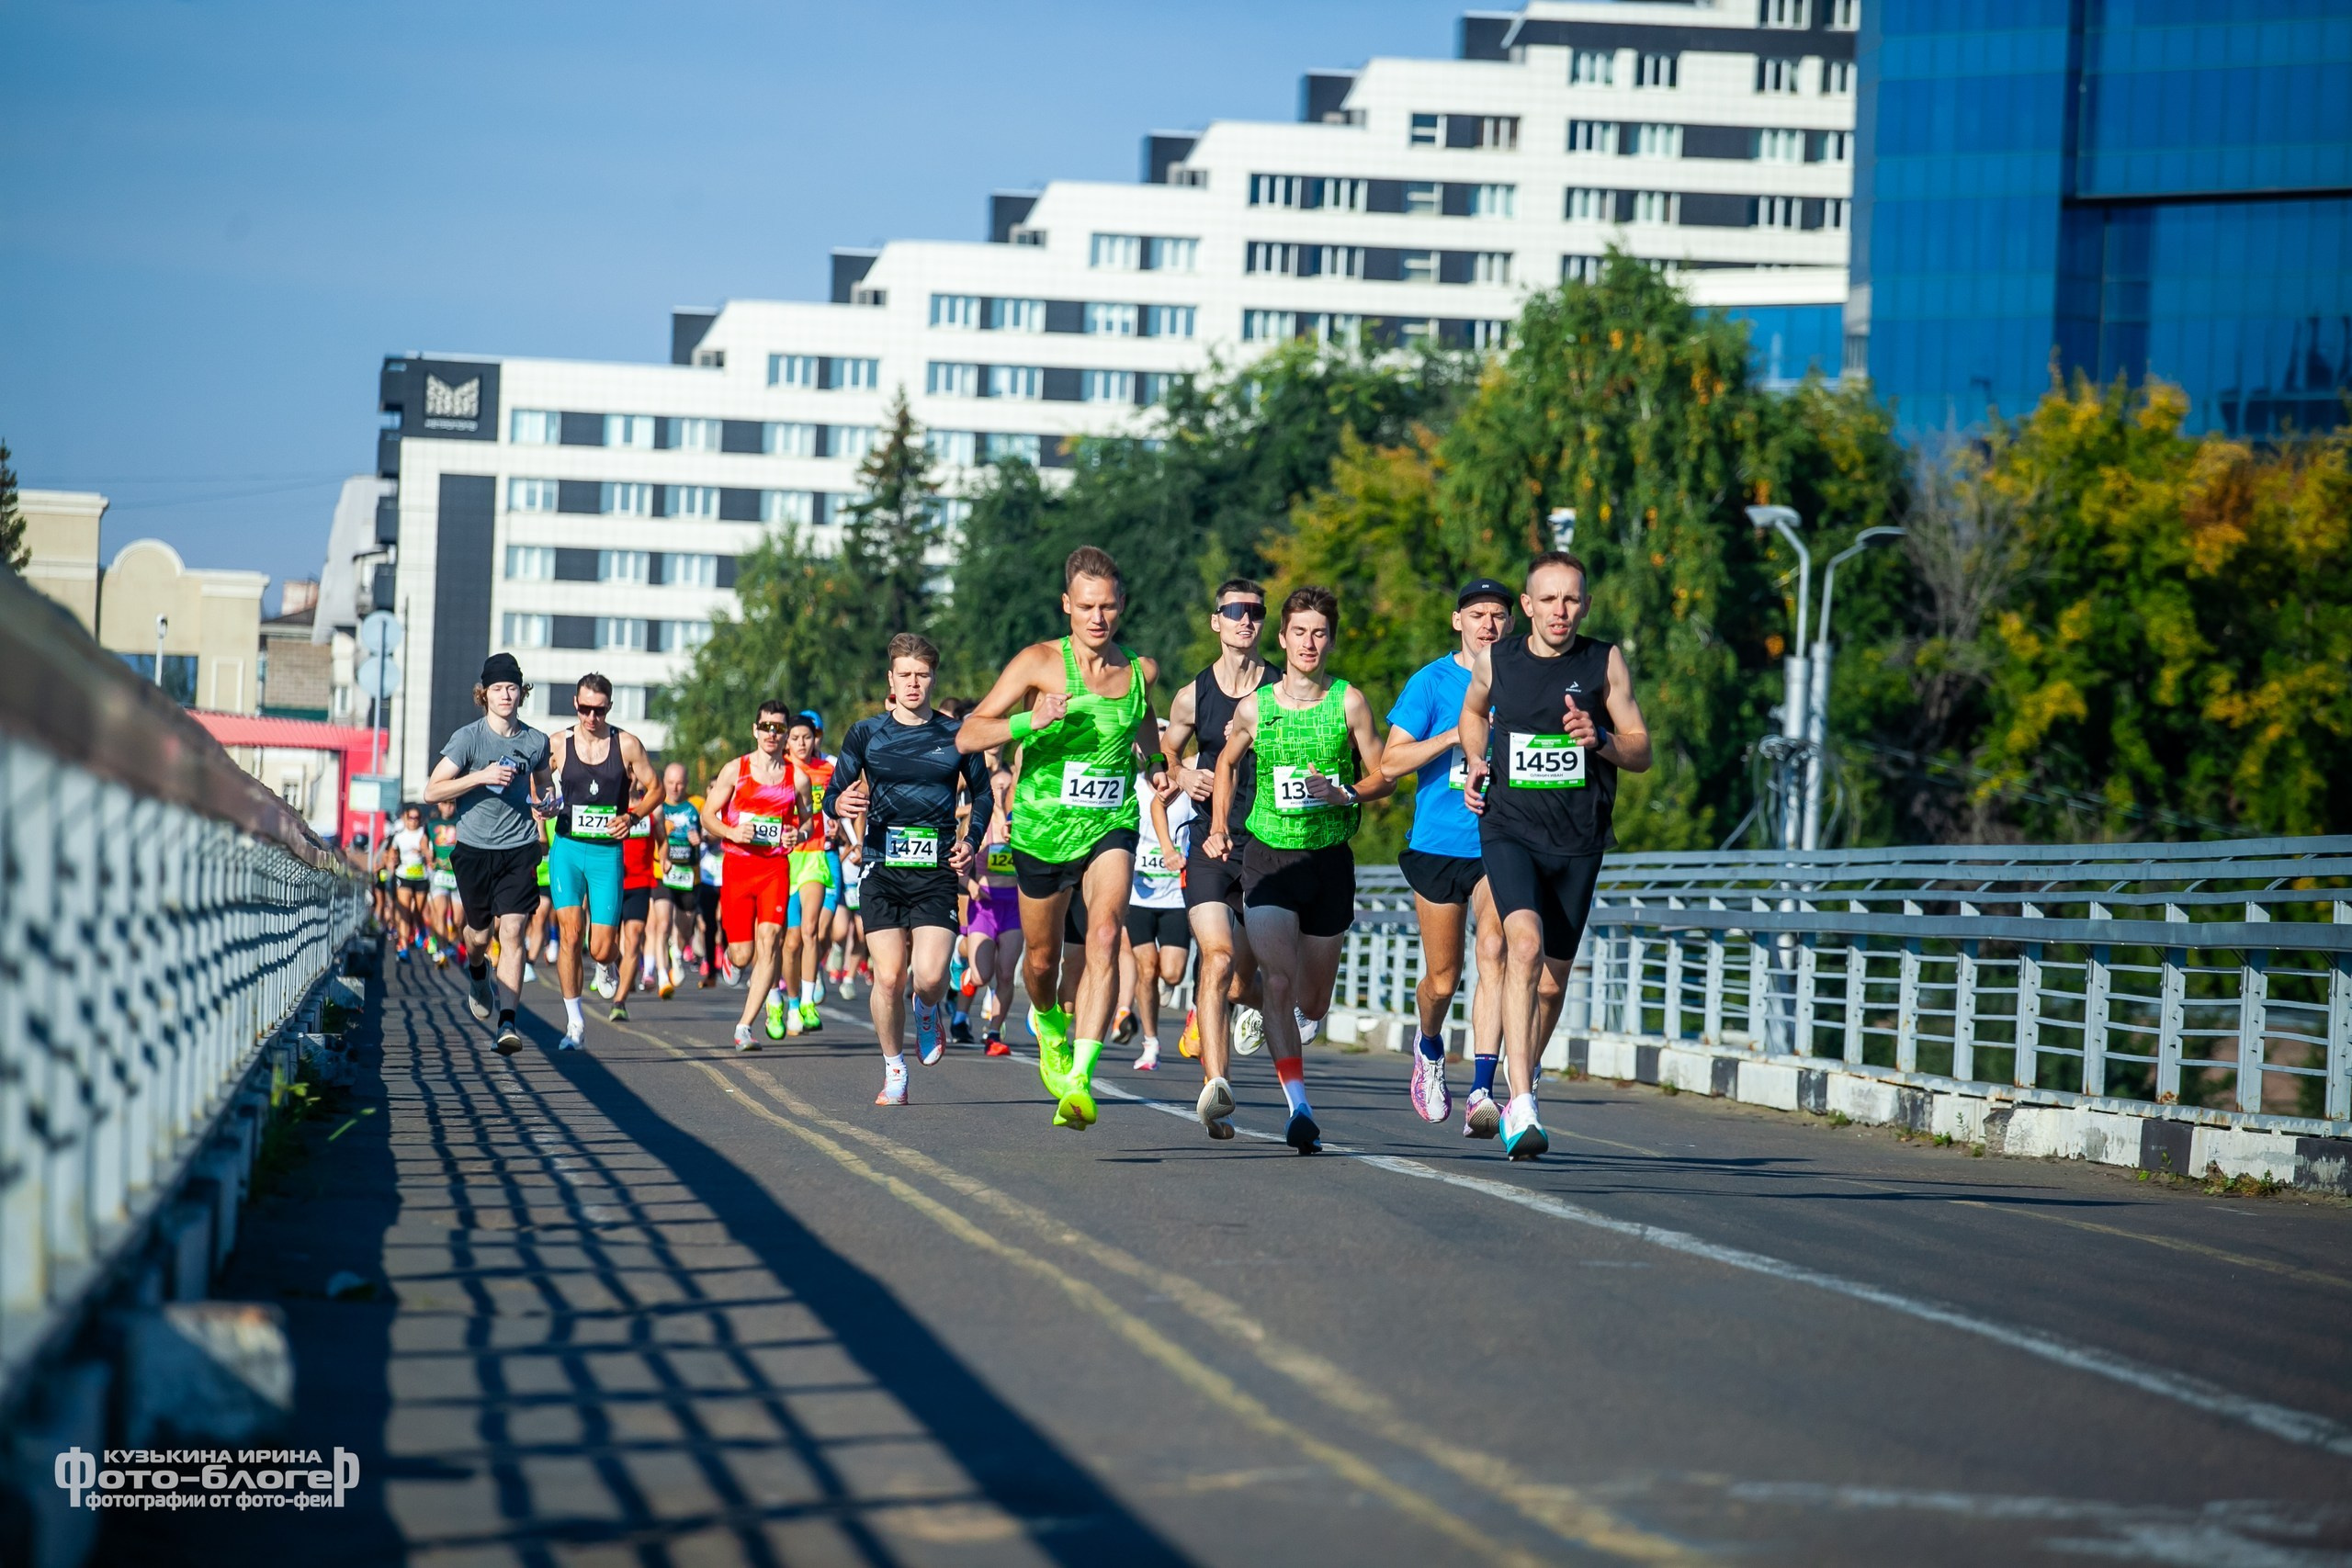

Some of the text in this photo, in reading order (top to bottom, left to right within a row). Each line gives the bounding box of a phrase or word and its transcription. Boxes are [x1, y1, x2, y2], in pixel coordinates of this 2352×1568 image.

[1515, 750, 1578, 773] 1459
[1069, 778, 1120, 799] 1472
[578, 815, 609, 828] 1271
[890, 840, 933, 855] 1474
